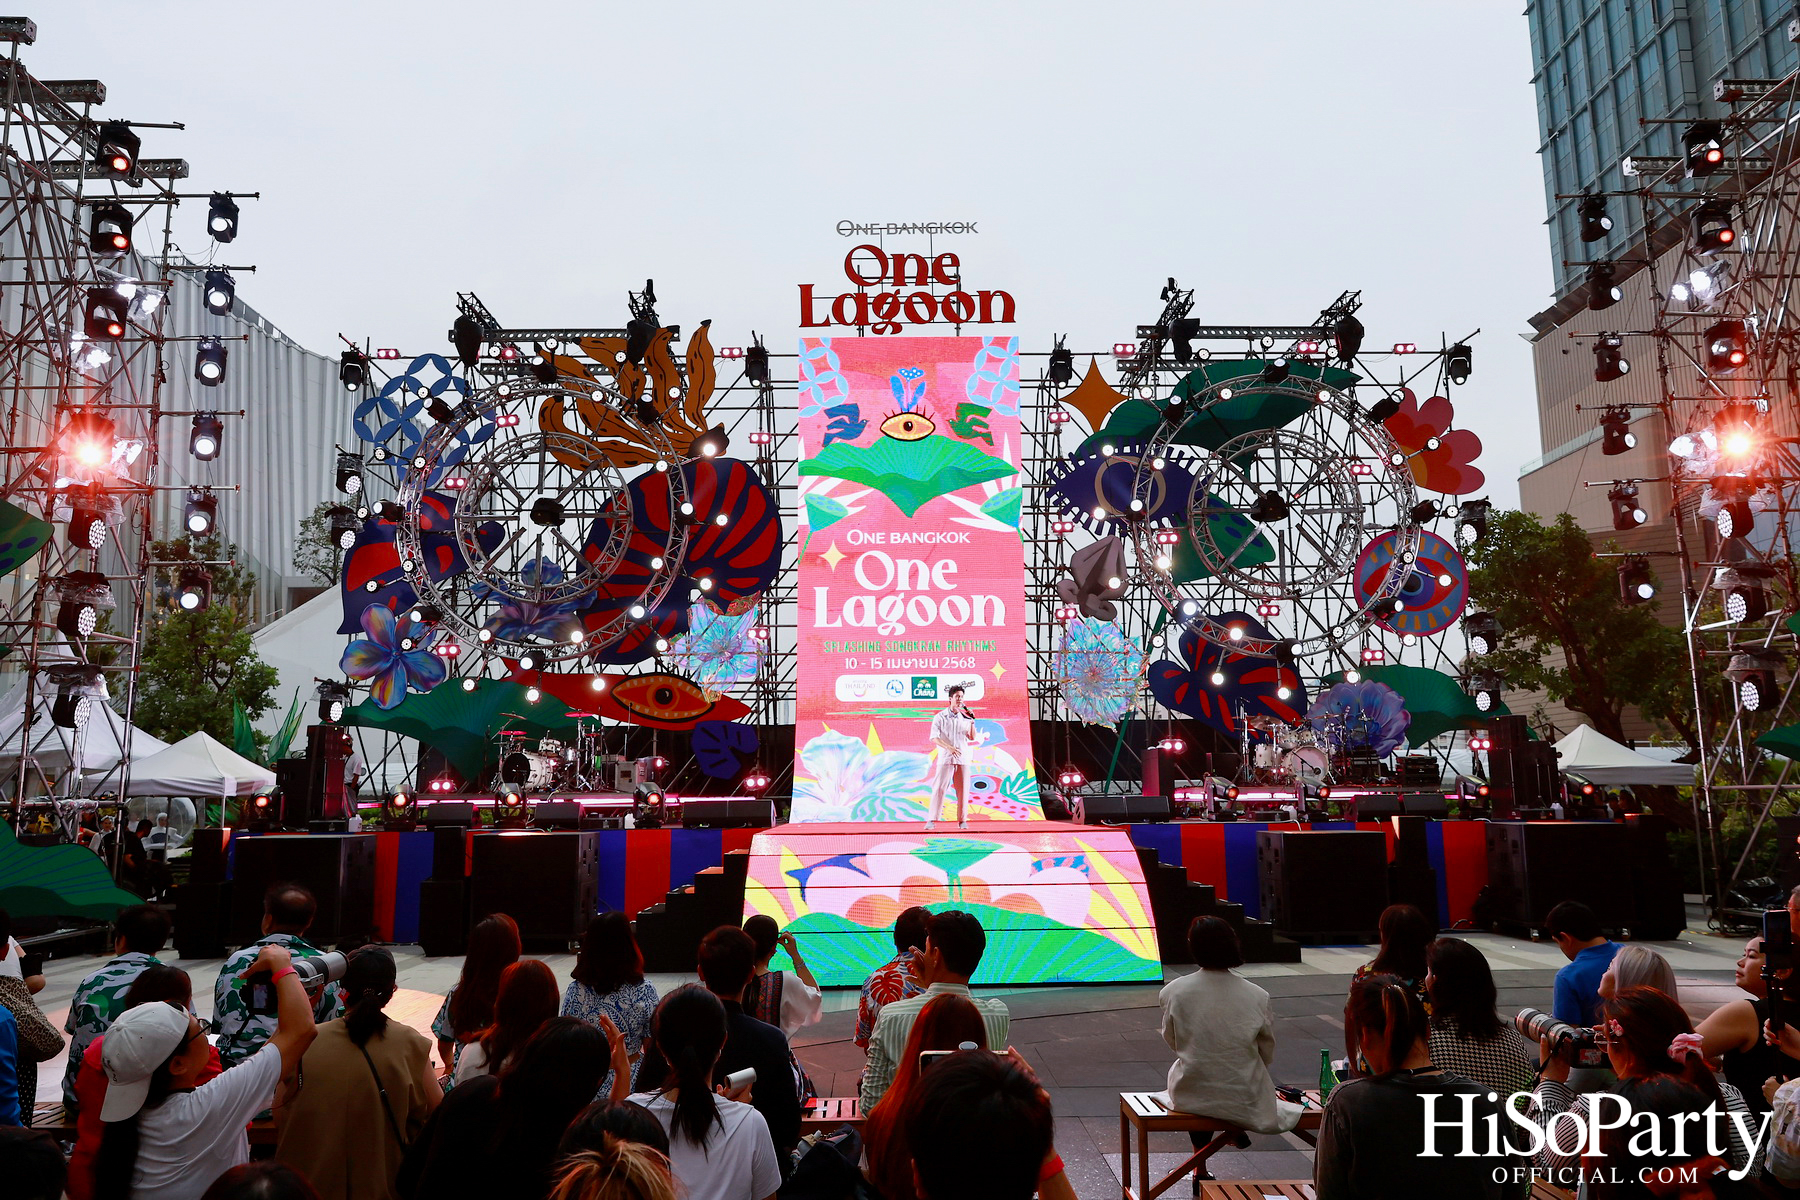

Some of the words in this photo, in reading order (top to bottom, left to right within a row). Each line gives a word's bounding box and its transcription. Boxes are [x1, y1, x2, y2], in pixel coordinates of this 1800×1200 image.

[836, 219, 881, 237] ONE
[886, 221, 979, 236] BANGKOK
[844, 244, 961, 287] One
[797, 283, 1016, 335] Lagoon
[846, 529, 886, 546] ONE
[890, 531, 971, 544] BANGKOK
[854, 550, 958, 591] One
[813, 586, 1006, 636] Lagoon
[824, 641, 881, 653] SPLASHING
[886, 640, 941, 652] SONGKRAN
[946, 640, 997, 652] RHYTHMS
[845, 657, 858, 670] 10
[870, 657, 883, 670] 15
[887, 657, 939, 669] เมษายน
[941, 656, 976, 669] 2568
